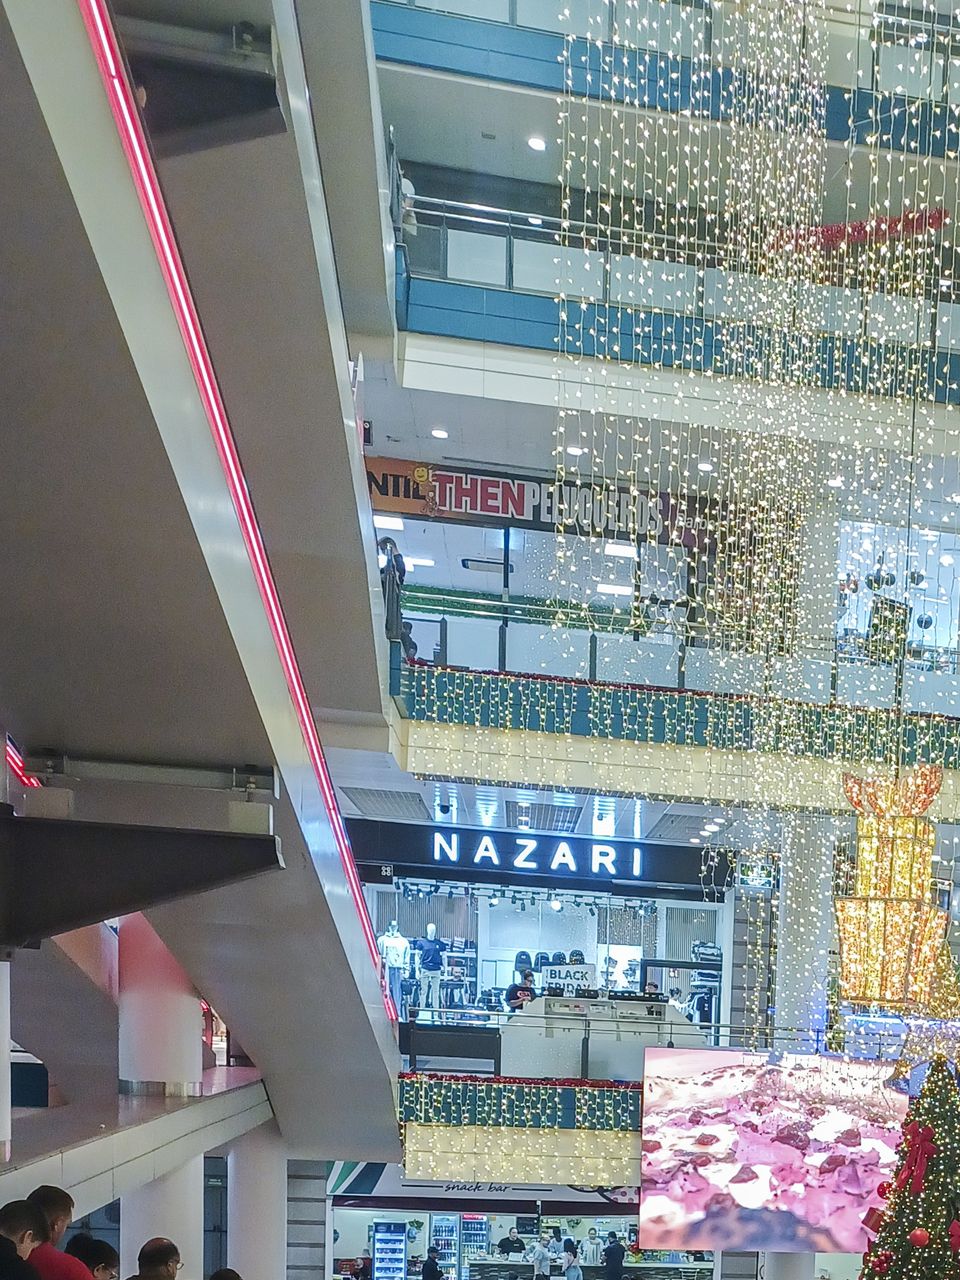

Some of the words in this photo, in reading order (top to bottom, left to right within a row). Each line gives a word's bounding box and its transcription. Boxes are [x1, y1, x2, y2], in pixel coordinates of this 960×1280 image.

[431, 472, 527, 520] THEN
[525, 480, 664, 536] PELUQUEROS
[433, 832, 641, 876] NAZARI
[549, 969, 589, 981] BLACK
[444, 1182, 484, 1192] snack
[487, 1182, 511, 1193] bar
